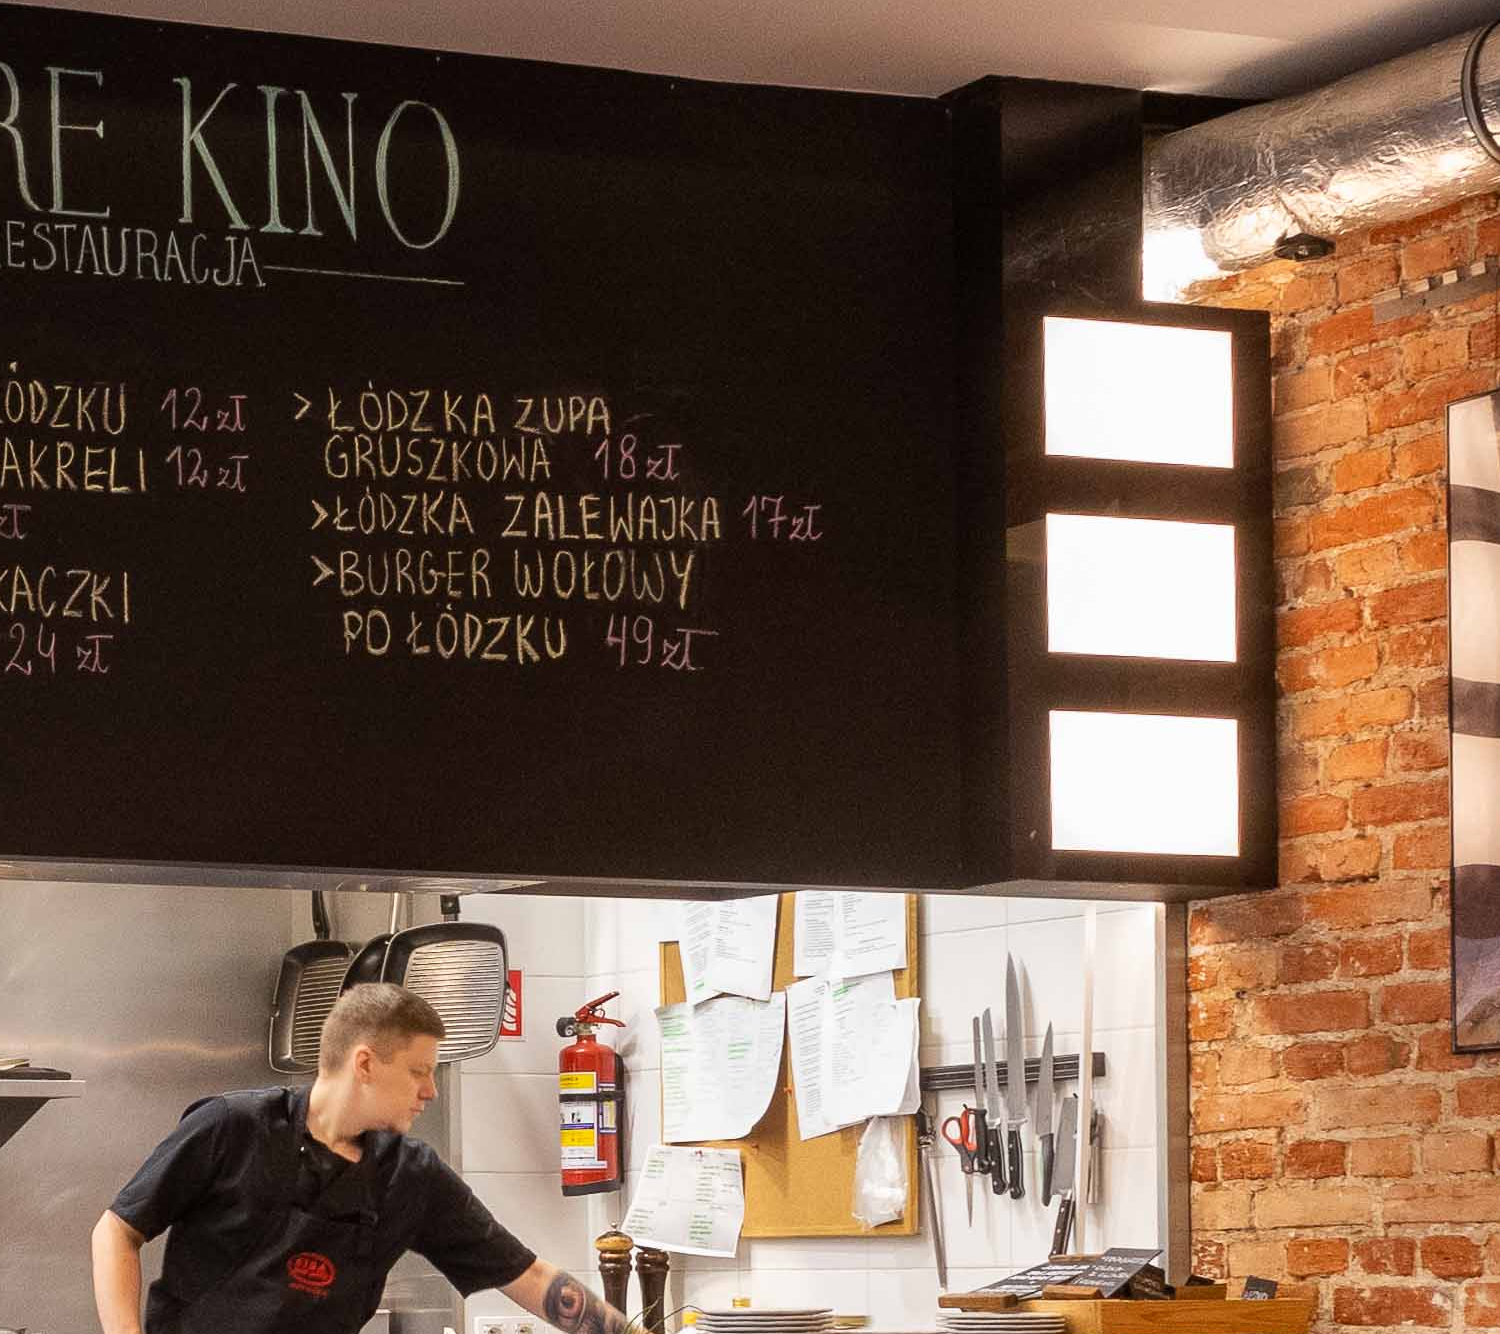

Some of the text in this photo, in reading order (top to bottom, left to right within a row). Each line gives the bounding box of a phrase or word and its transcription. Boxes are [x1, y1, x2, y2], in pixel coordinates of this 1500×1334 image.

[172, 76, 461, 250] KINO
[160, 386, 210, 434] 12
[327, 380, 612, 435] ŁÓDZKA ZUPA
[165, 443, 210, 492] 12
[323, 433, 552, 482] GRUSZKOWA
[594, 433, 638, 482] 18
[332, 486, 475, 536] ŁÓDZKA
[500, 491, 722, 543] ZALEWAJKA
[742, 493, 786, 541] 17
[339, 547, 697, 610] BURGER WOŁOWY
[3, 621, 57, 676] 24
[342, 609, 392, 656] PO
[405, 603, 568, 665] ŁÓDZKU
[604, 614, 653, 668] 49
